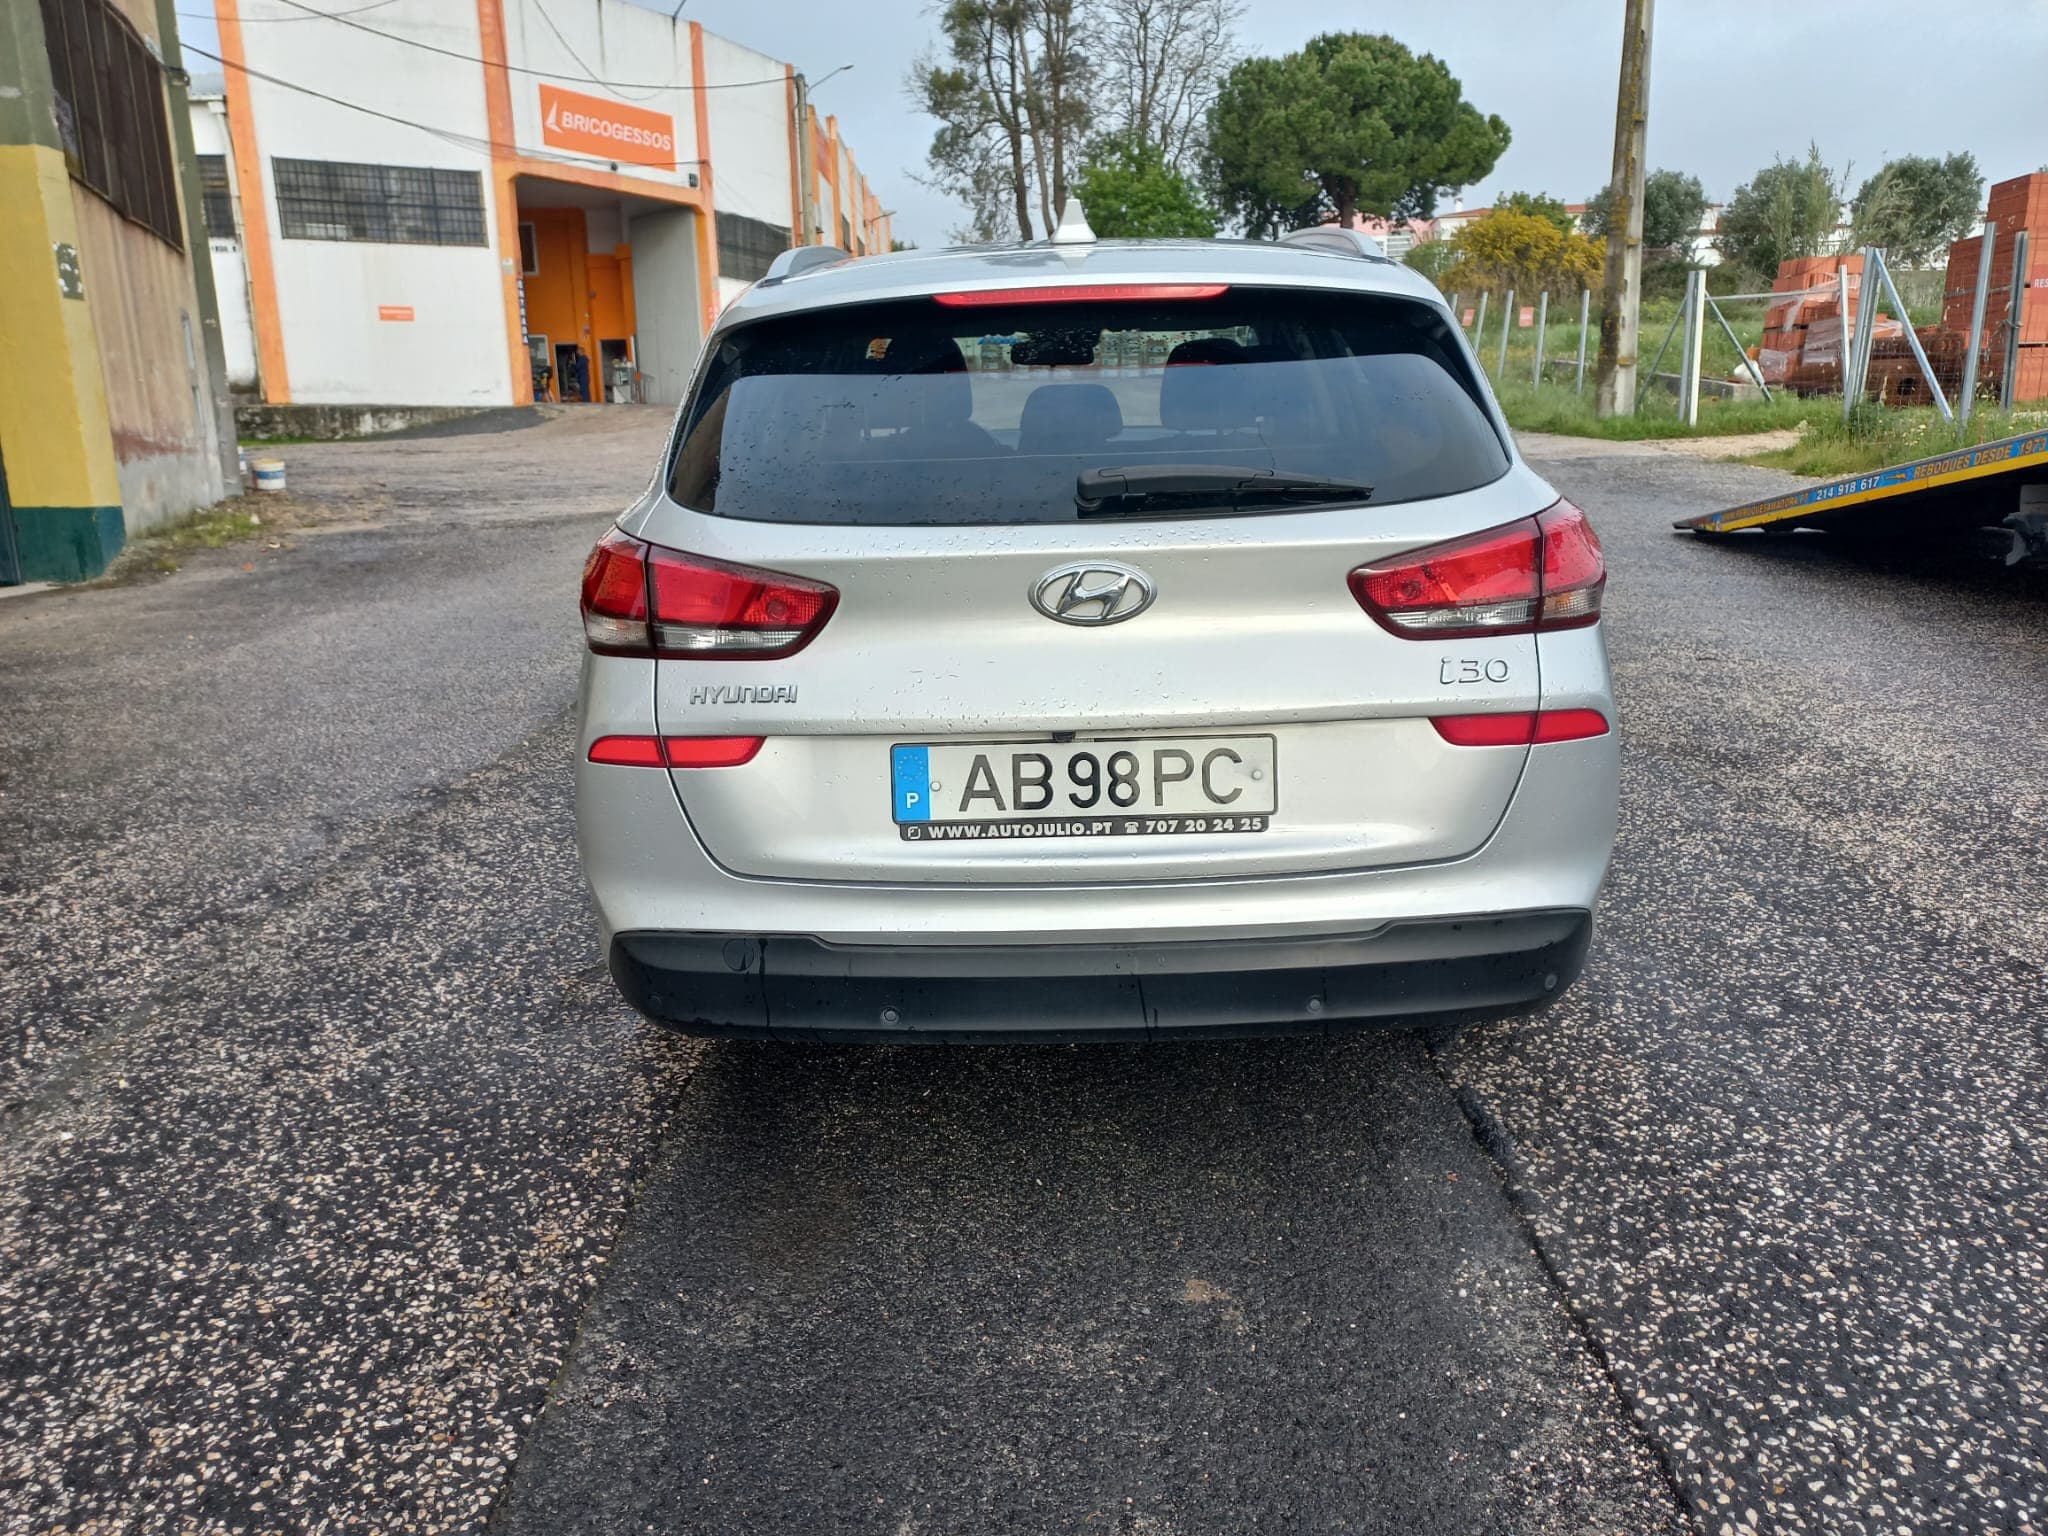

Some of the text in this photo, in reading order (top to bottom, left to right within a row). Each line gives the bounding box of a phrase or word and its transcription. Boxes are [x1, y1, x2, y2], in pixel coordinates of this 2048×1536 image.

[561, 110, 672, 151] BRICOGESSOS
[1817, 487, 1834, 500] 214
[1837, 481, 1856, 496] 918
[1860, 475, 1880, 490] 617
[1914, 454, 1971, 479] REBOQUES
[1974, 444, 2011, 465] DESDE
[1440, 655, 1511, 685] i30
[689, 684, 798, 705] HYUNDAI
[905, 792, 920, 809] P
[928, 817, 1262, 839] WWW.AUTOJULIO.PT 707 20 24 25
